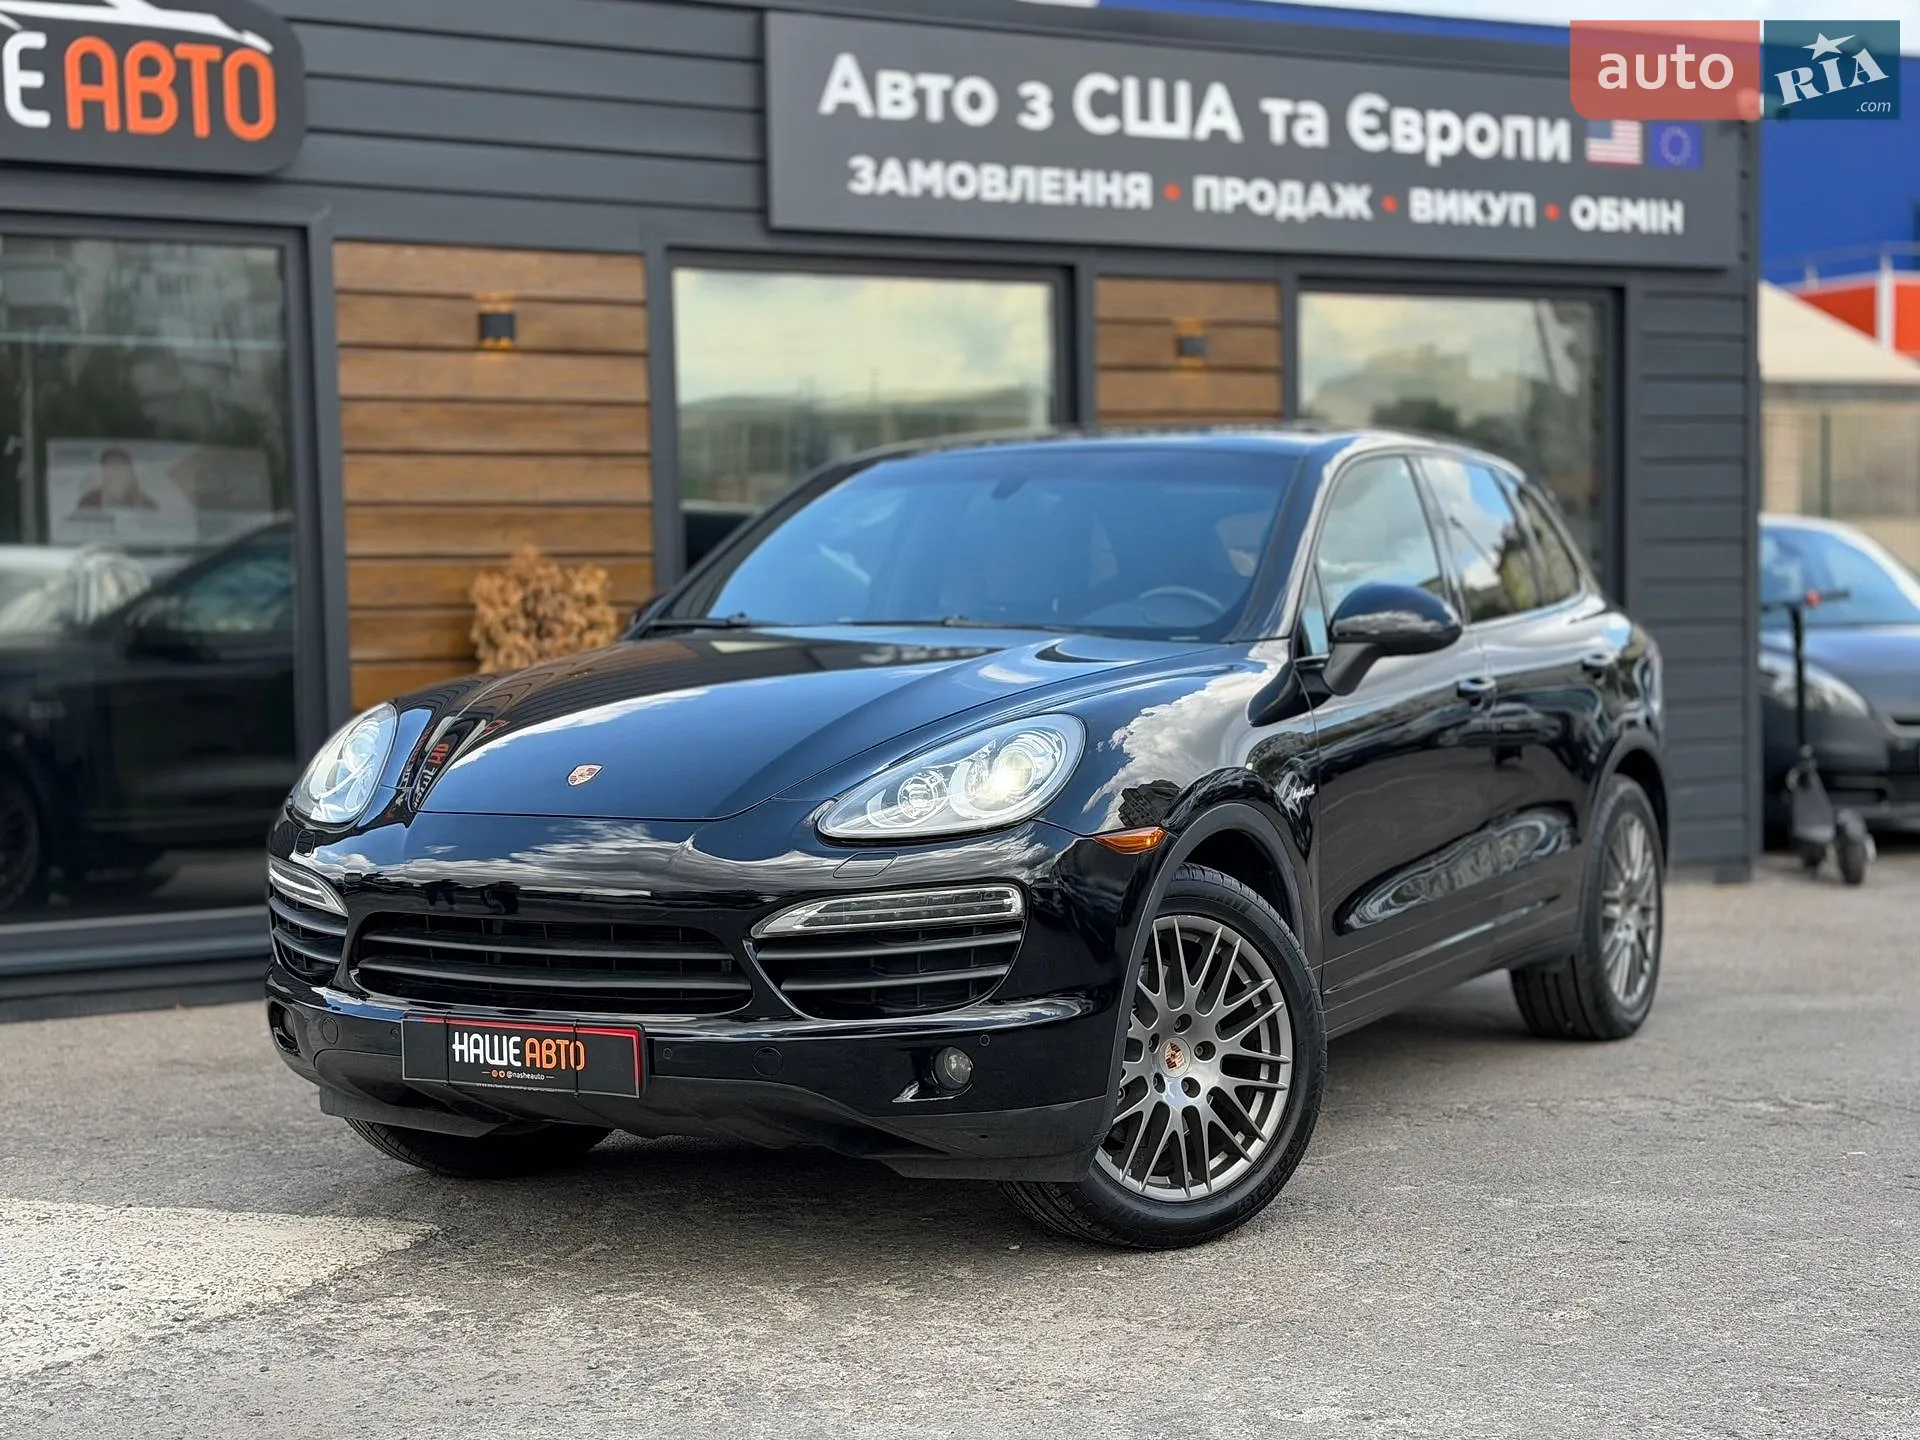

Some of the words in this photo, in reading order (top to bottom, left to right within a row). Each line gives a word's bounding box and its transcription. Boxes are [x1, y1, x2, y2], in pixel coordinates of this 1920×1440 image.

[65, 35, 276, 142] АВТО
[1017, 81, 1054, 131] з
[1073, 72, 1244, 142] США
[1260, 97, 1328, 147] та
[1346, 92, 1571, 166] Європи
[847, 154, 1153, 210] ЗАМОВЛЕННЯ
[1192, 174, 1373, 222] ПРОДАЖ
[1409, 187, 1536, 228] ВИКУП
[1569, 194, 1685, 234] ОБМІН
[452, 1031, 522, 1067] НАШЕ
[525, 1037, 585, 1071] АВТО
